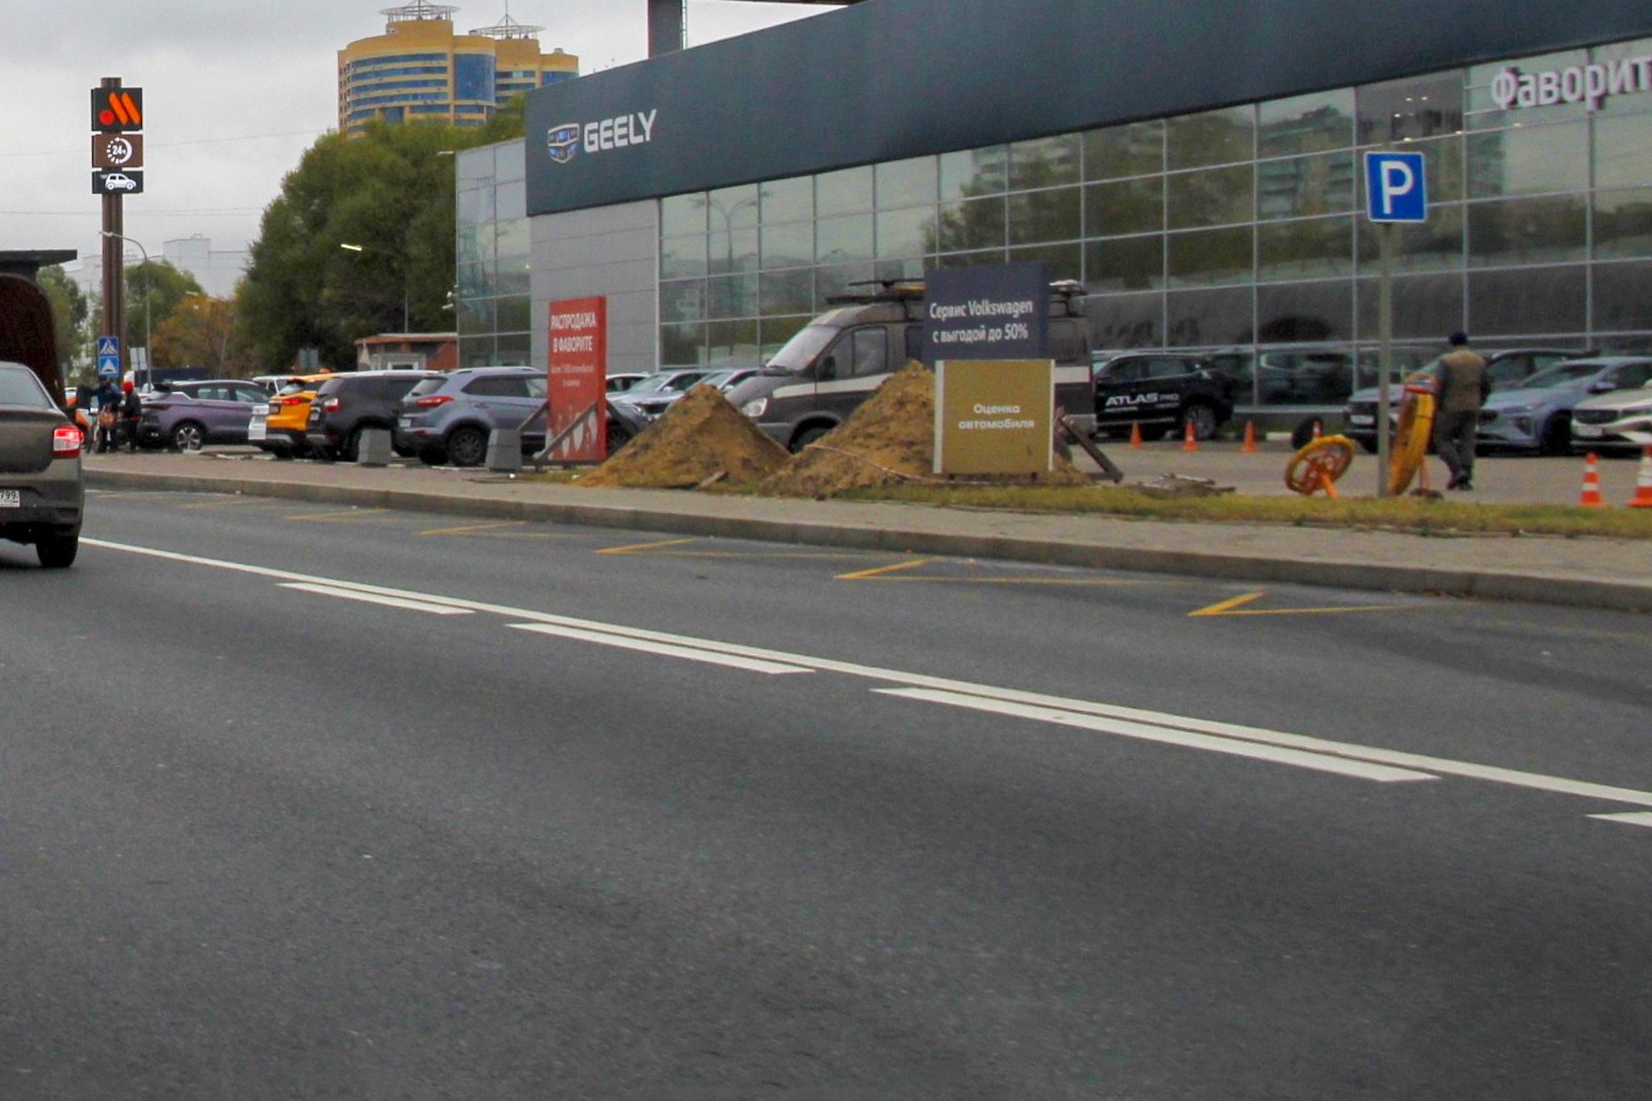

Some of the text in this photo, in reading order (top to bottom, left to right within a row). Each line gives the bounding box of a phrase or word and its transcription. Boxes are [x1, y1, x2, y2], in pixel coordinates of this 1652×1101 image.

[584, 109, 657, 153] GEELY
[929, 299, 1034, 321] Сервис Volkswagen
[551, 311, 597, 331] РАСПРОДАЖА
[933, 322, 1029, 343] с выгодой до 50%
[973, 403, 1021, 416] Оценка
[1105, 392, 1159, 407] ATLAS
[958, 418, 1035, 430] автомобиля
